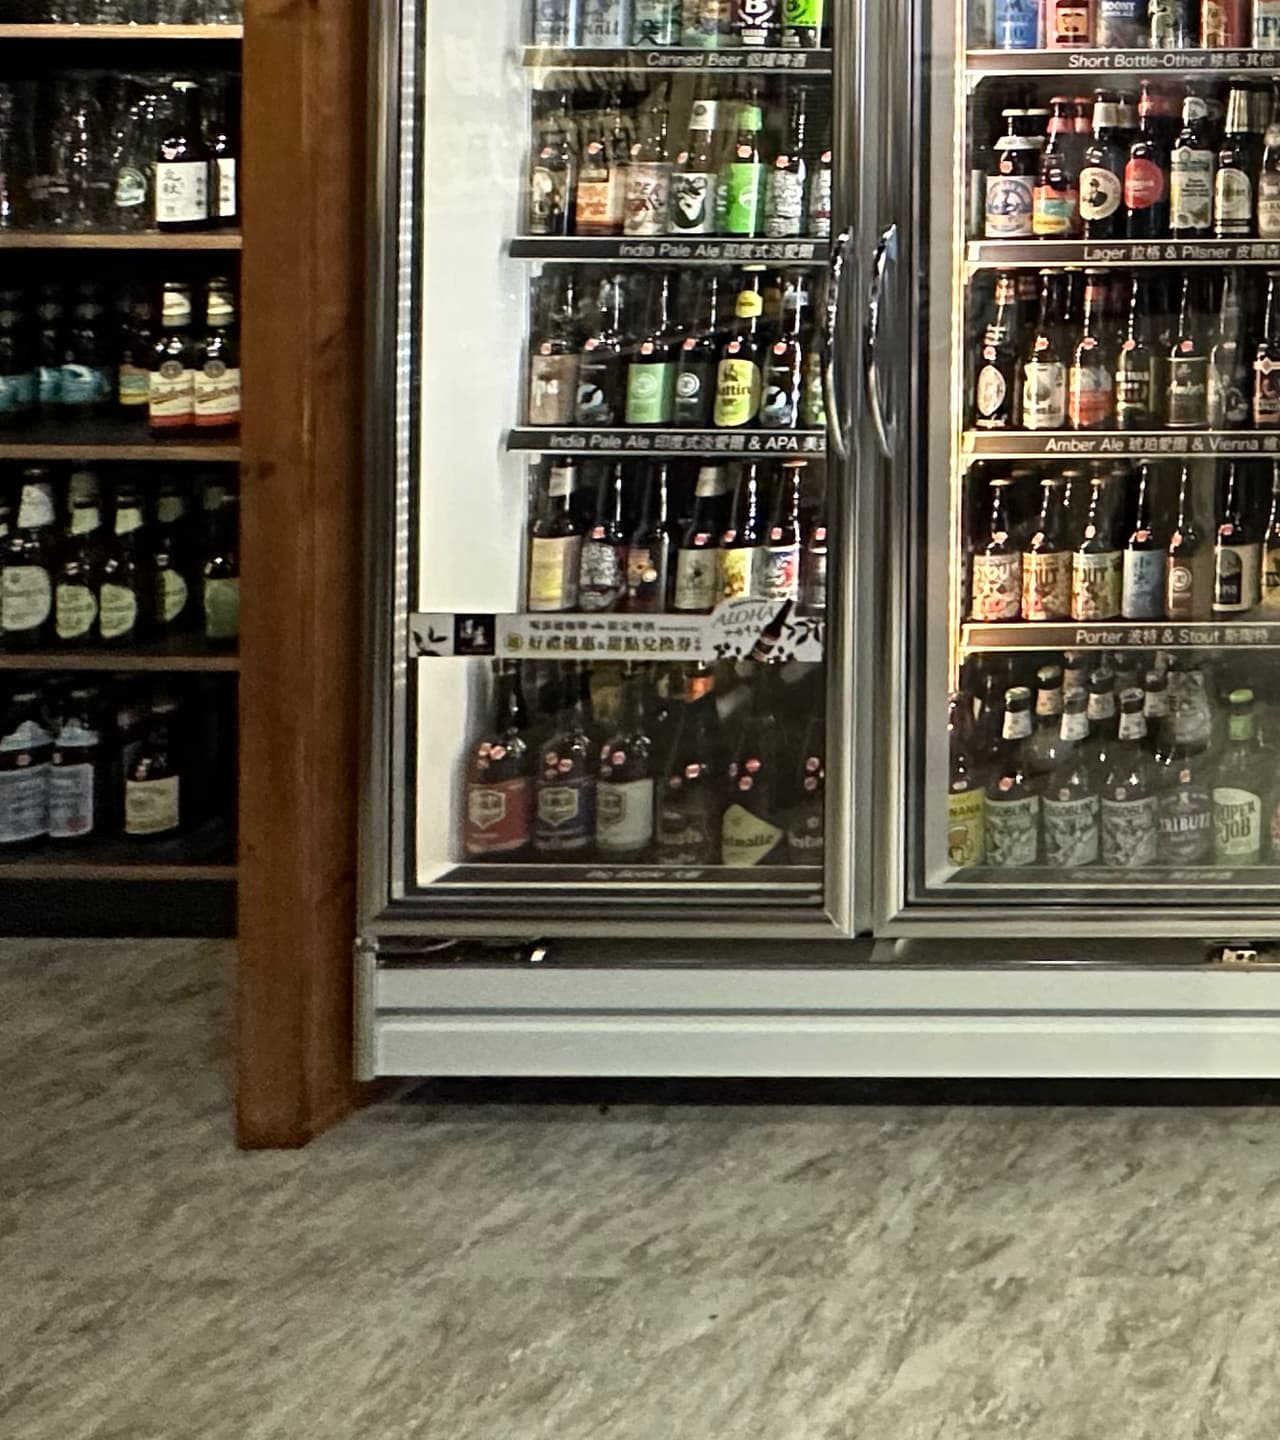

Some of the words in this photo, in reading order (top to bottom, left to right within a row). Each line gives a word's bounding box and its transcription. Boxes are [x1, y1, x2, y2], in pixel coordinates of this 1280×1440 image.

[647, 52, 704, 67] Canned
[708, 52, 744, 67] Beer
[1068, 54, 1110, 67] Short
[619, 243, 655, 257] India
[659, 243, 692, 257] Pale
[695, 243, 720, 257] Ale
[1083, 246, 1127, 262] Lager
[1164, 245, 1177, 260] &
[1182, 245, 1232, 260] Pilsner
[549, 434, 586, 448] India
[589, 434, 622, 448] Pale
[625, 434, 650, 448] Ale
[748, 435, 761, 449] &
[765, 435, 799, 449] APA
[1045, 438, 1095, 452] Amber
[1100, 438, 1124, 451] Ale
[1192, 438, 1203, 451] &
[1209, 437, 1259, 451] Vienna
[1075, 629, 1123, 644] Porter
[1162, 630, 1174, 643] &
[1179, 629, 1220, 644] Stout
[1223, 816, 1251, 844] JOB
